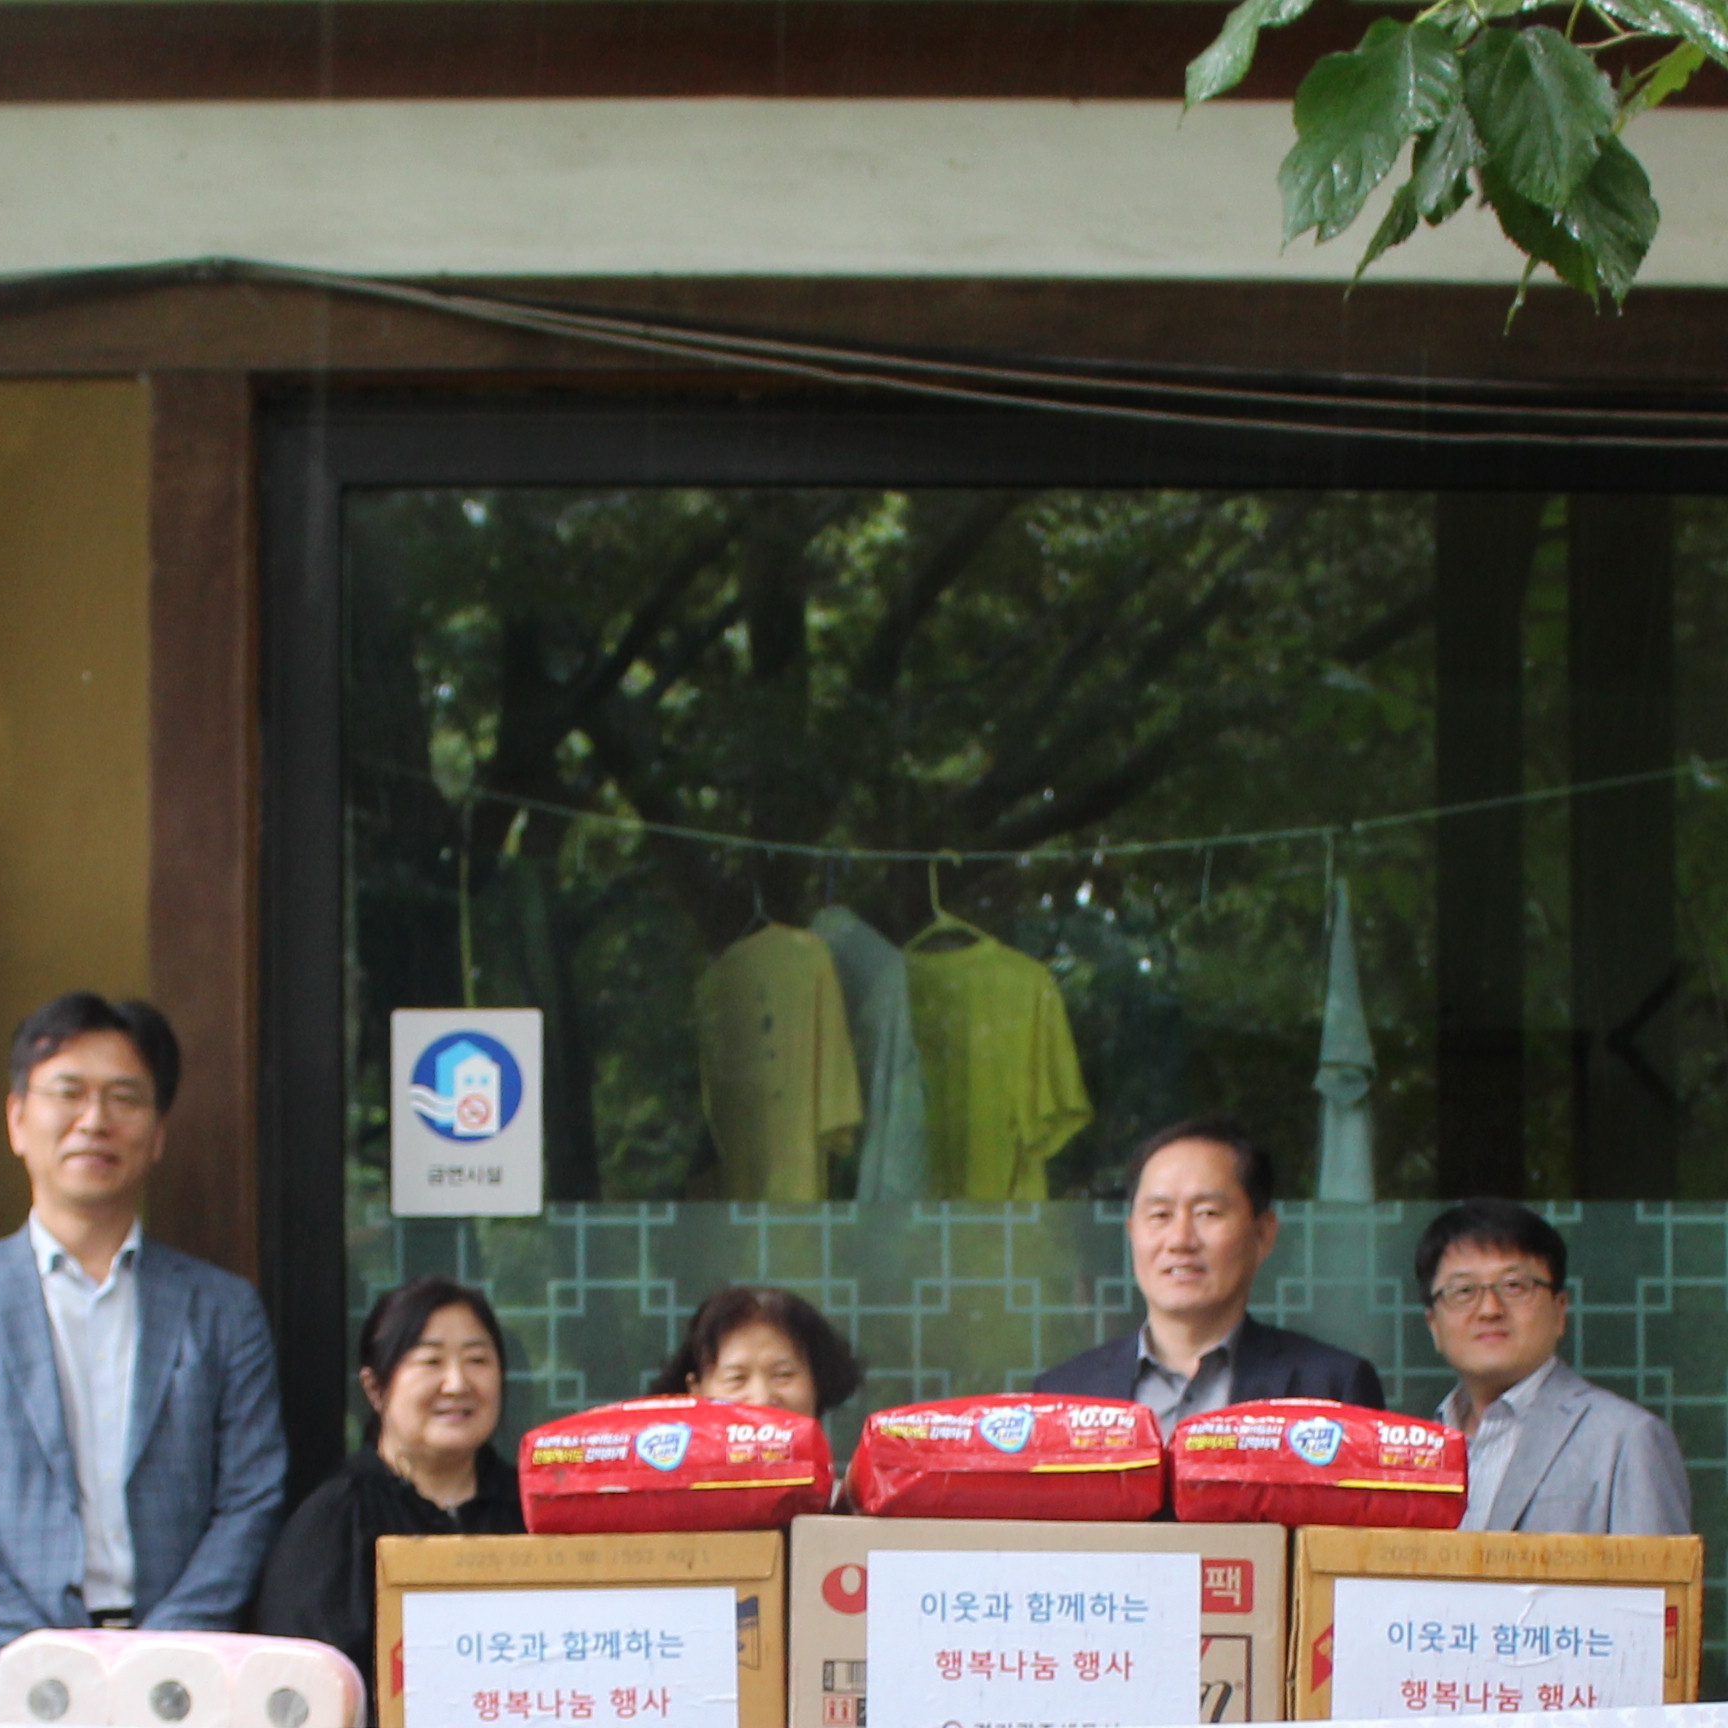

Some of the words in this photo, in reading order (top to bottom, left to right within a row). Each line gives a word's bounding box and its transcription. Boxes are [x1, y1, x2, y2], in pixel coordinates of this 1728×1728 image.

[428, 1164, 502, 1186] 금연시설
[920, 1591, 1014, 1624] 이웃과
[1027, 1591, 1150, 1625] 함께하는
[456, 1632, 549, 1663] 이웃과
[562, 1629, 685, 1662] 함께하는
[1387, 1620, 1480, 1655] 이웃과
[1492, 1623, 1615, 1658] 함께하는
[935, 1649, 1060, 1681] 행복나눔
[1073, 1650, 1134, 1681] 행사
[473, 1688, 596, 1721] 행복나눔
[610, 1687, 671, 1719] 행사
[1400, 1680, 1523, 1712] 행복나눔
[1537, 1684, 1598, 1711] 행사
